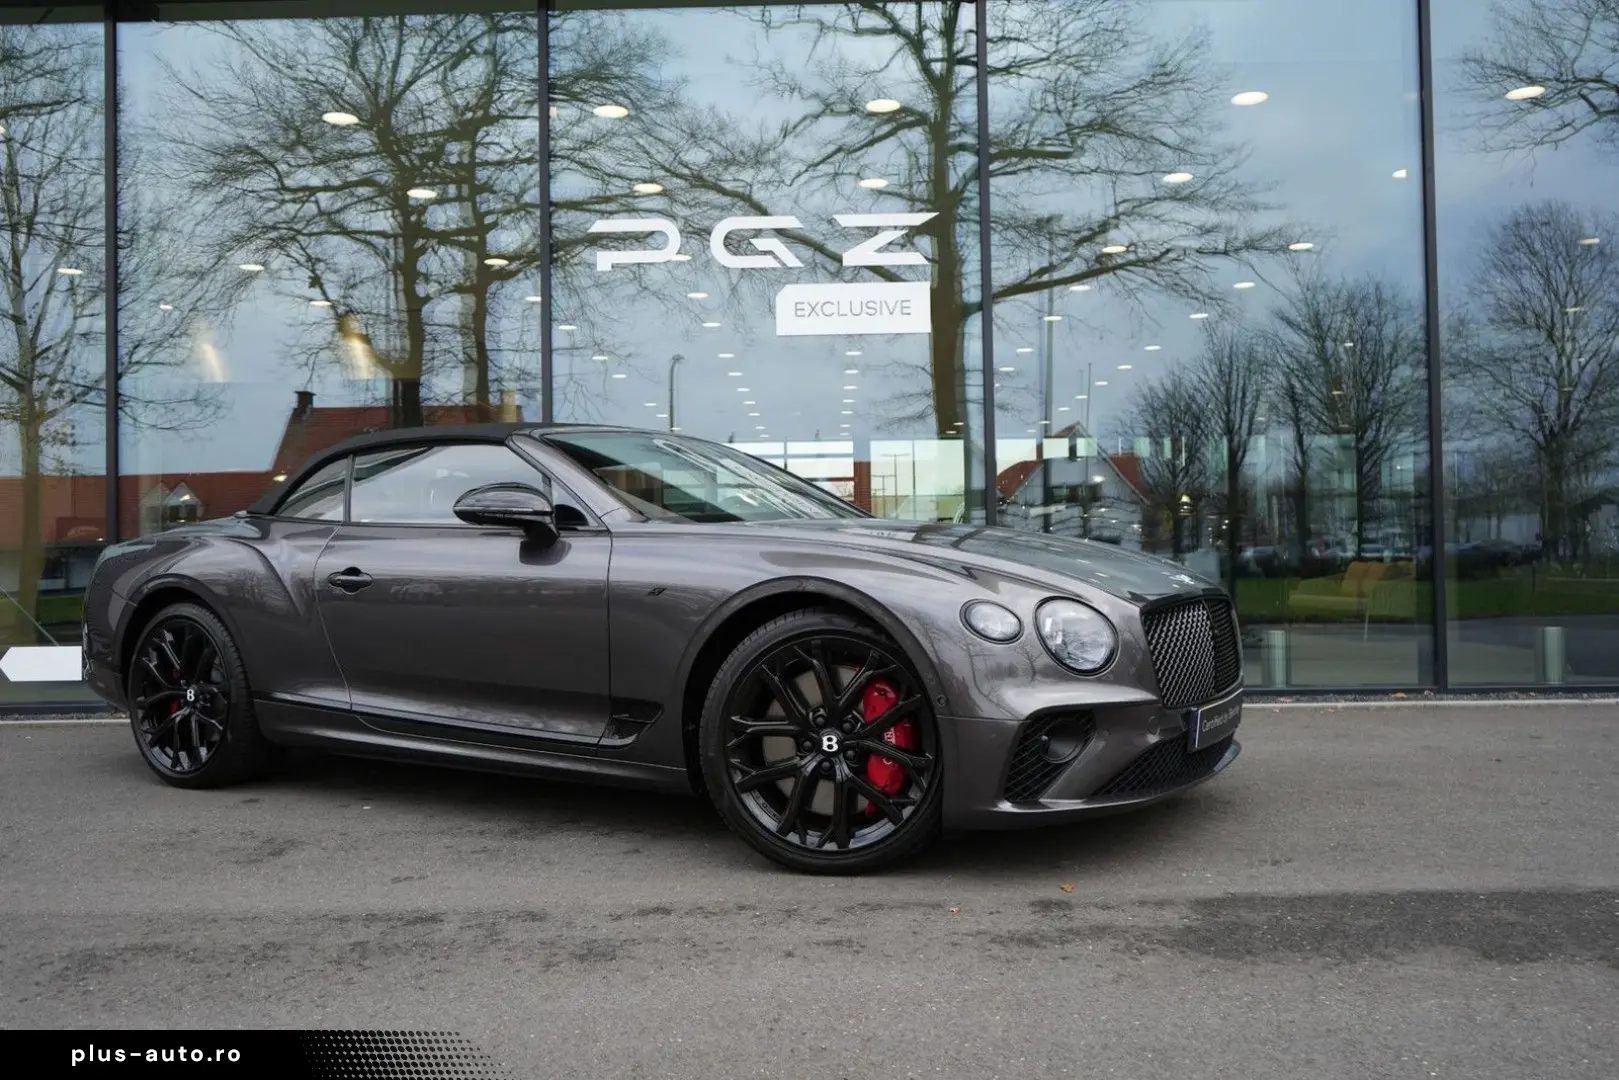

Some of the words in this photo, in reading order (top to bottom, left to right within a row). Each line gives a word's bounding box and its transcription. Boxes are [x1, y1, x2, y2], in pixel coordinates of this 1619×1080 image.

[587, 212, 940, 271] PGZ
[794, 299, 912, 318] EXCLUSIVE
[822, 735, 839, 752] B
